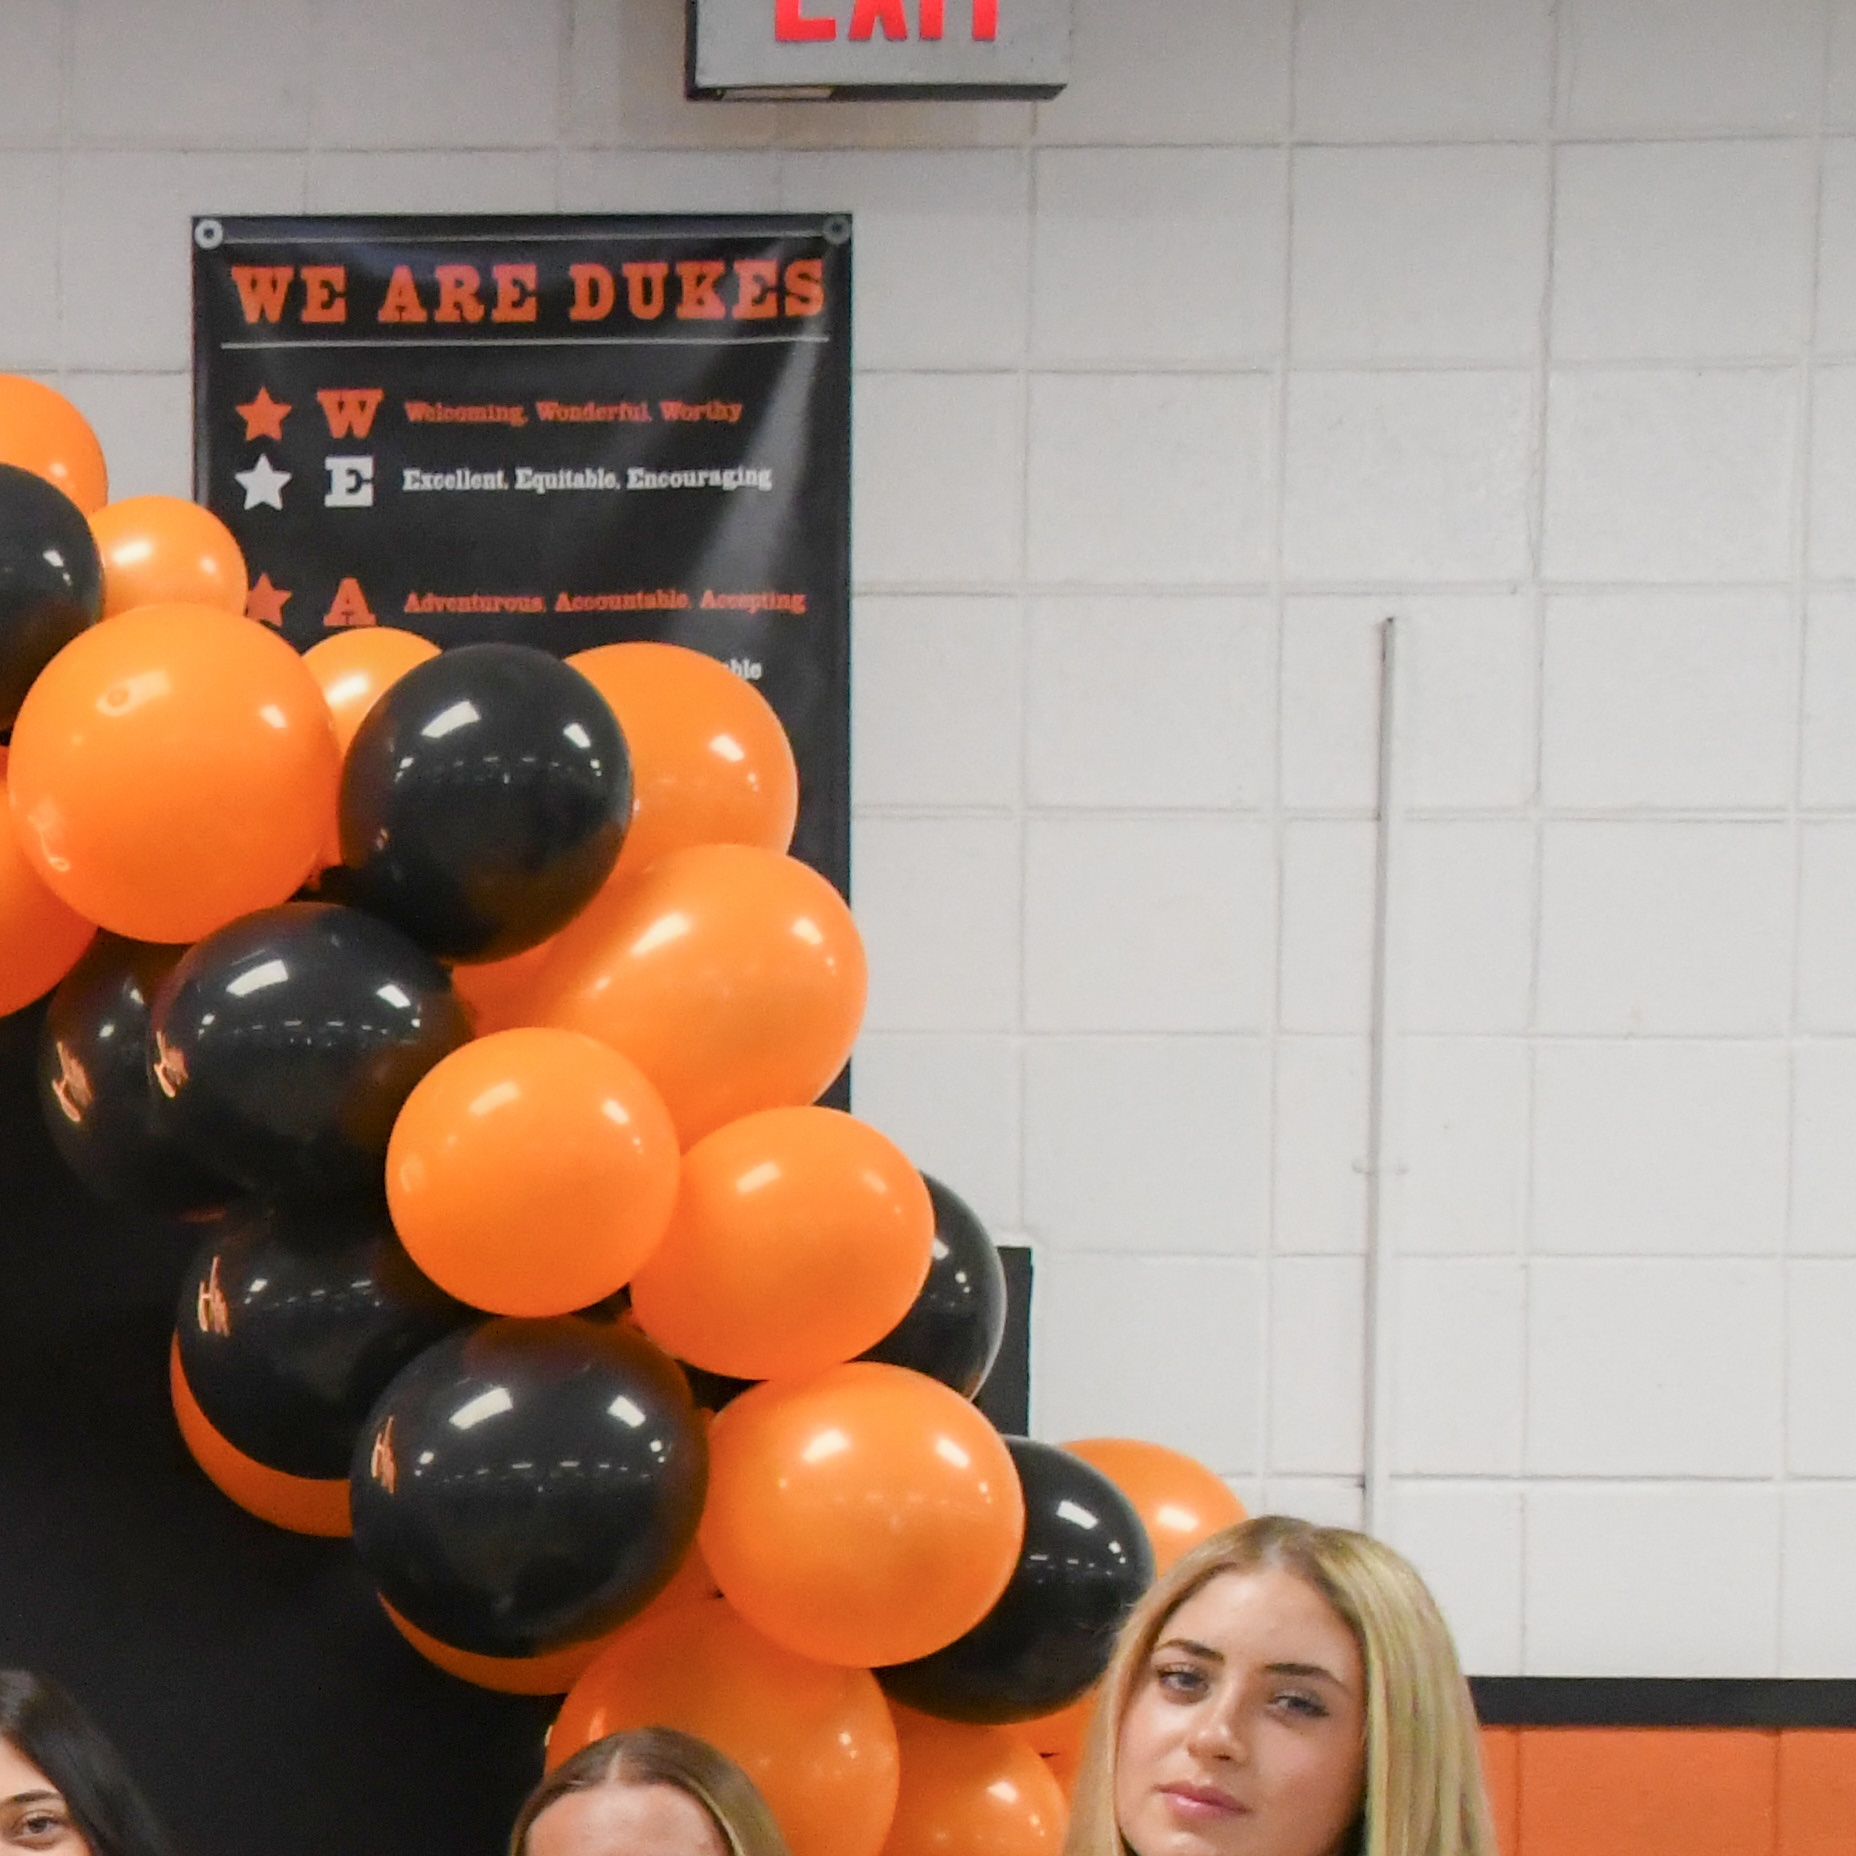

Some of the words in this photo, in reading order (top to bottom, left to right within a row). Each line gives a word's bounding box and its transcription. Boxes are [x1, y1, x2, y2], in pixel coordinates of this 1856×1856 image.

[231, 265, 347, 324] WE
[379, 263, 538, 324] ARE
[569, 258, 825, 323] DUKES
[317, 388, 383, 439] W
[660, 401, 742, 423] Worthy
[325, 456, 374, 507] E
[626, 466, 773, 491] Encouraging
[323, 577, 377, 627] A
[700, 589, 807, 614] Accepting
